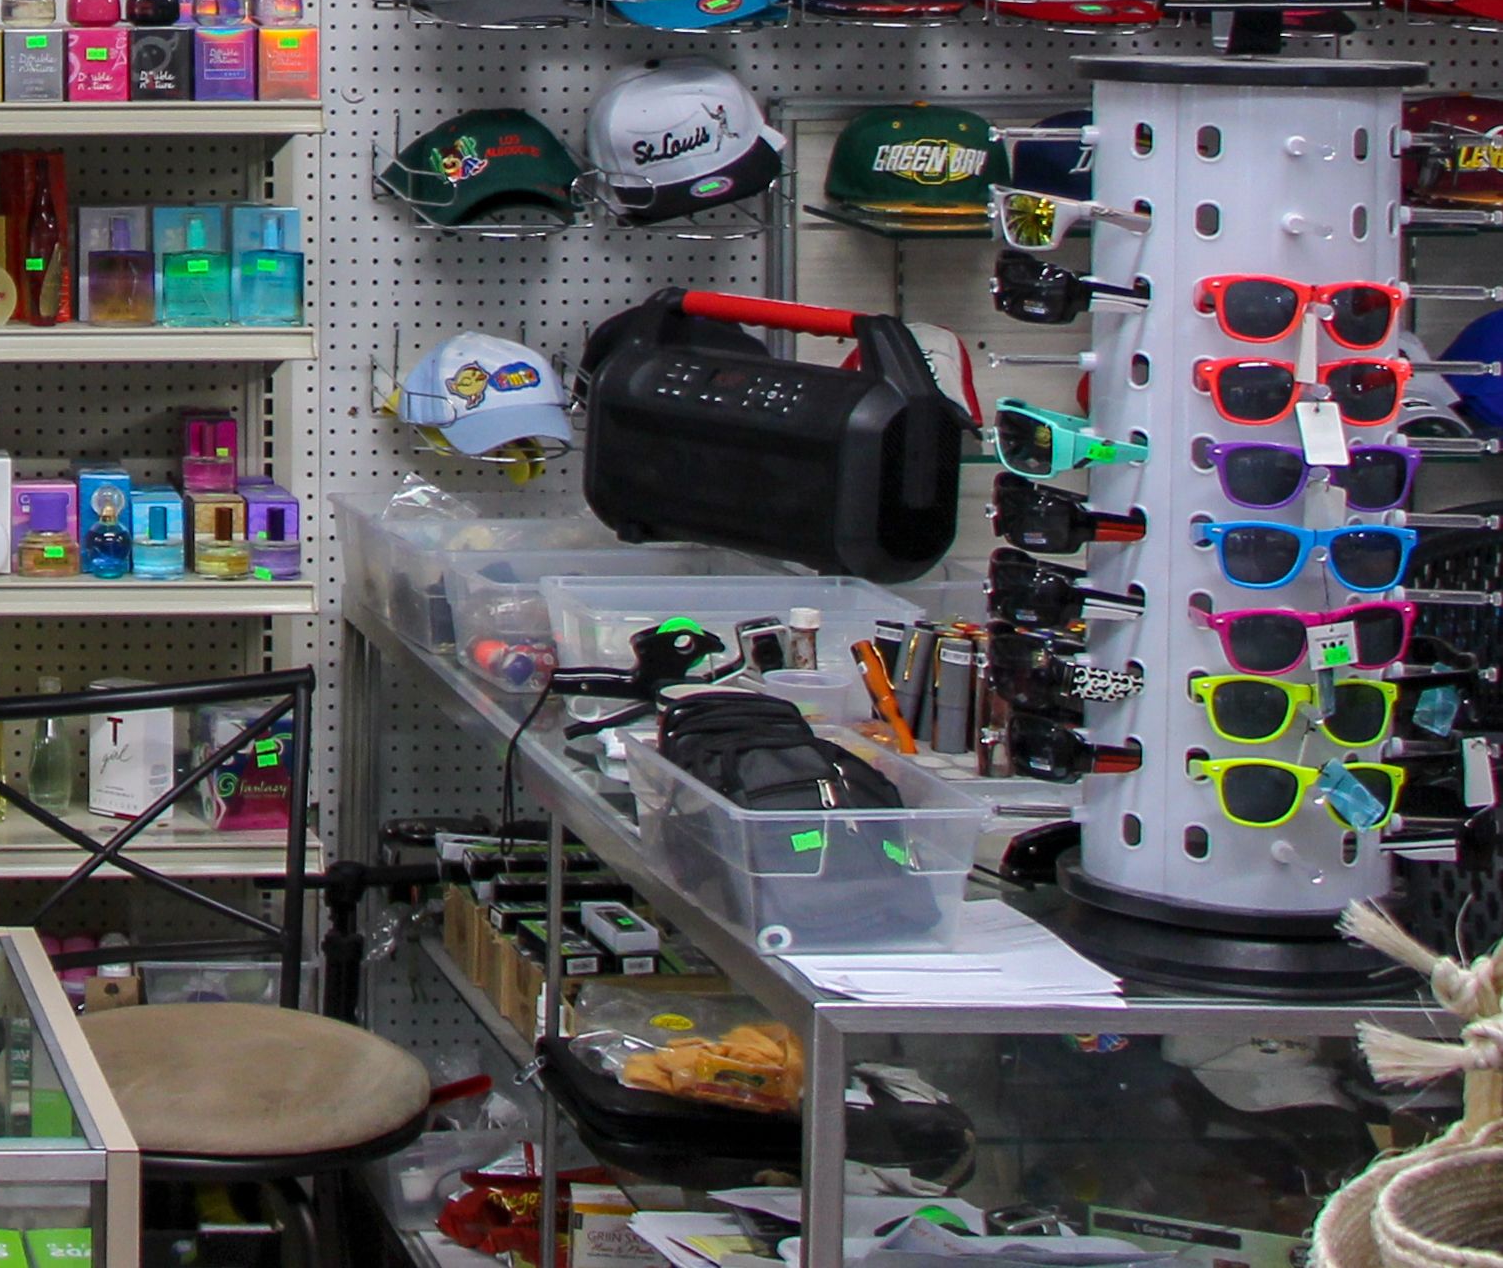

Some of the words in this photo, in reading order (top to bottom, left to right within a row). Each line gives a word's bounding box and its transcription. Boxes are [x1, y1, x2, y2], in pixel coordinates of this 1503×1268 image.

[659, 127, 710, 160] Louis
[872, 143, 944, 172] GREEN
[948, 148, 987, 176] BAY
